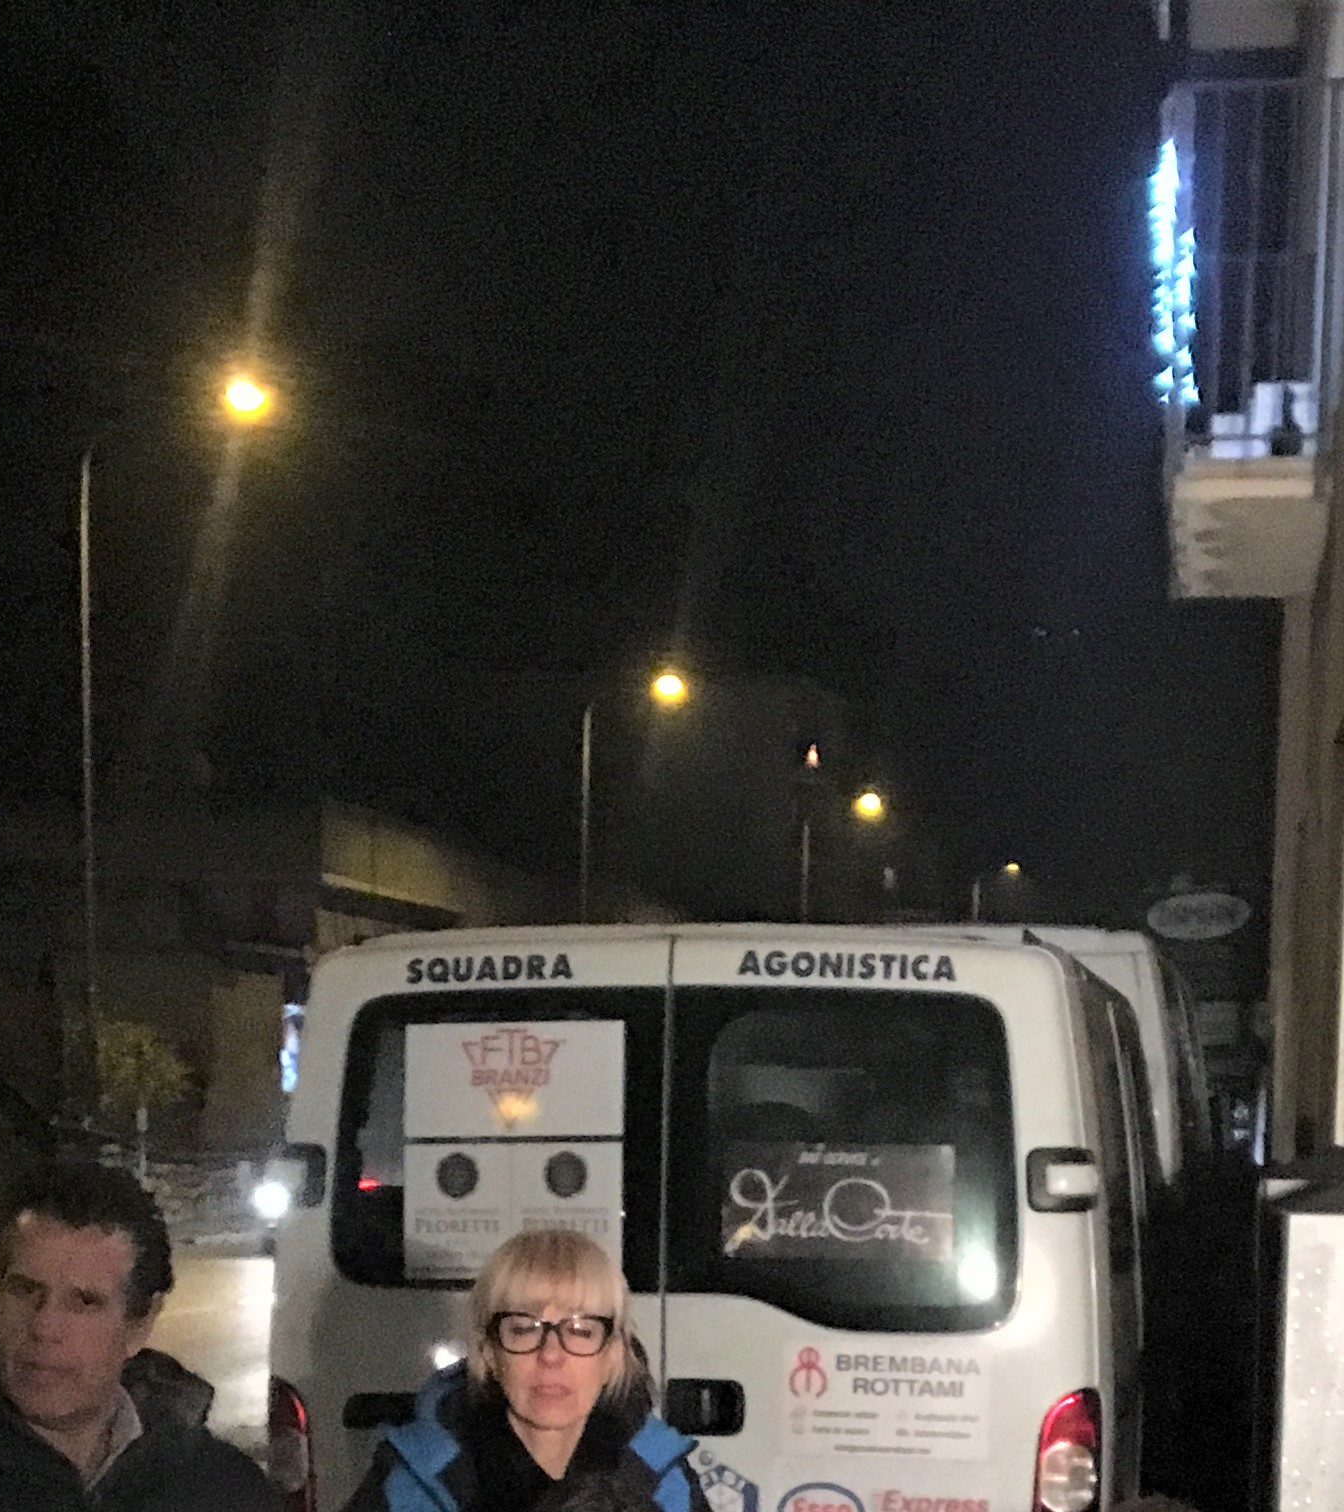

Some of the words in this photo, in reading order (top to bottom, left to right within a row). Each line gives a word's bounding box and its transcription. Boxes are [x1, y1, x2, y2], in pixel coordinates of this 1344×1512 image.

[406, 953, 573, 984] SQUADRA
[738, 949, 956, 982] AGONISTICA
[471, 1068, 552, 1087] BRANZI
[835, 1353, 982, 1376] BREMBANA
[852, 1376, 965, 1398] ROTTAMI
